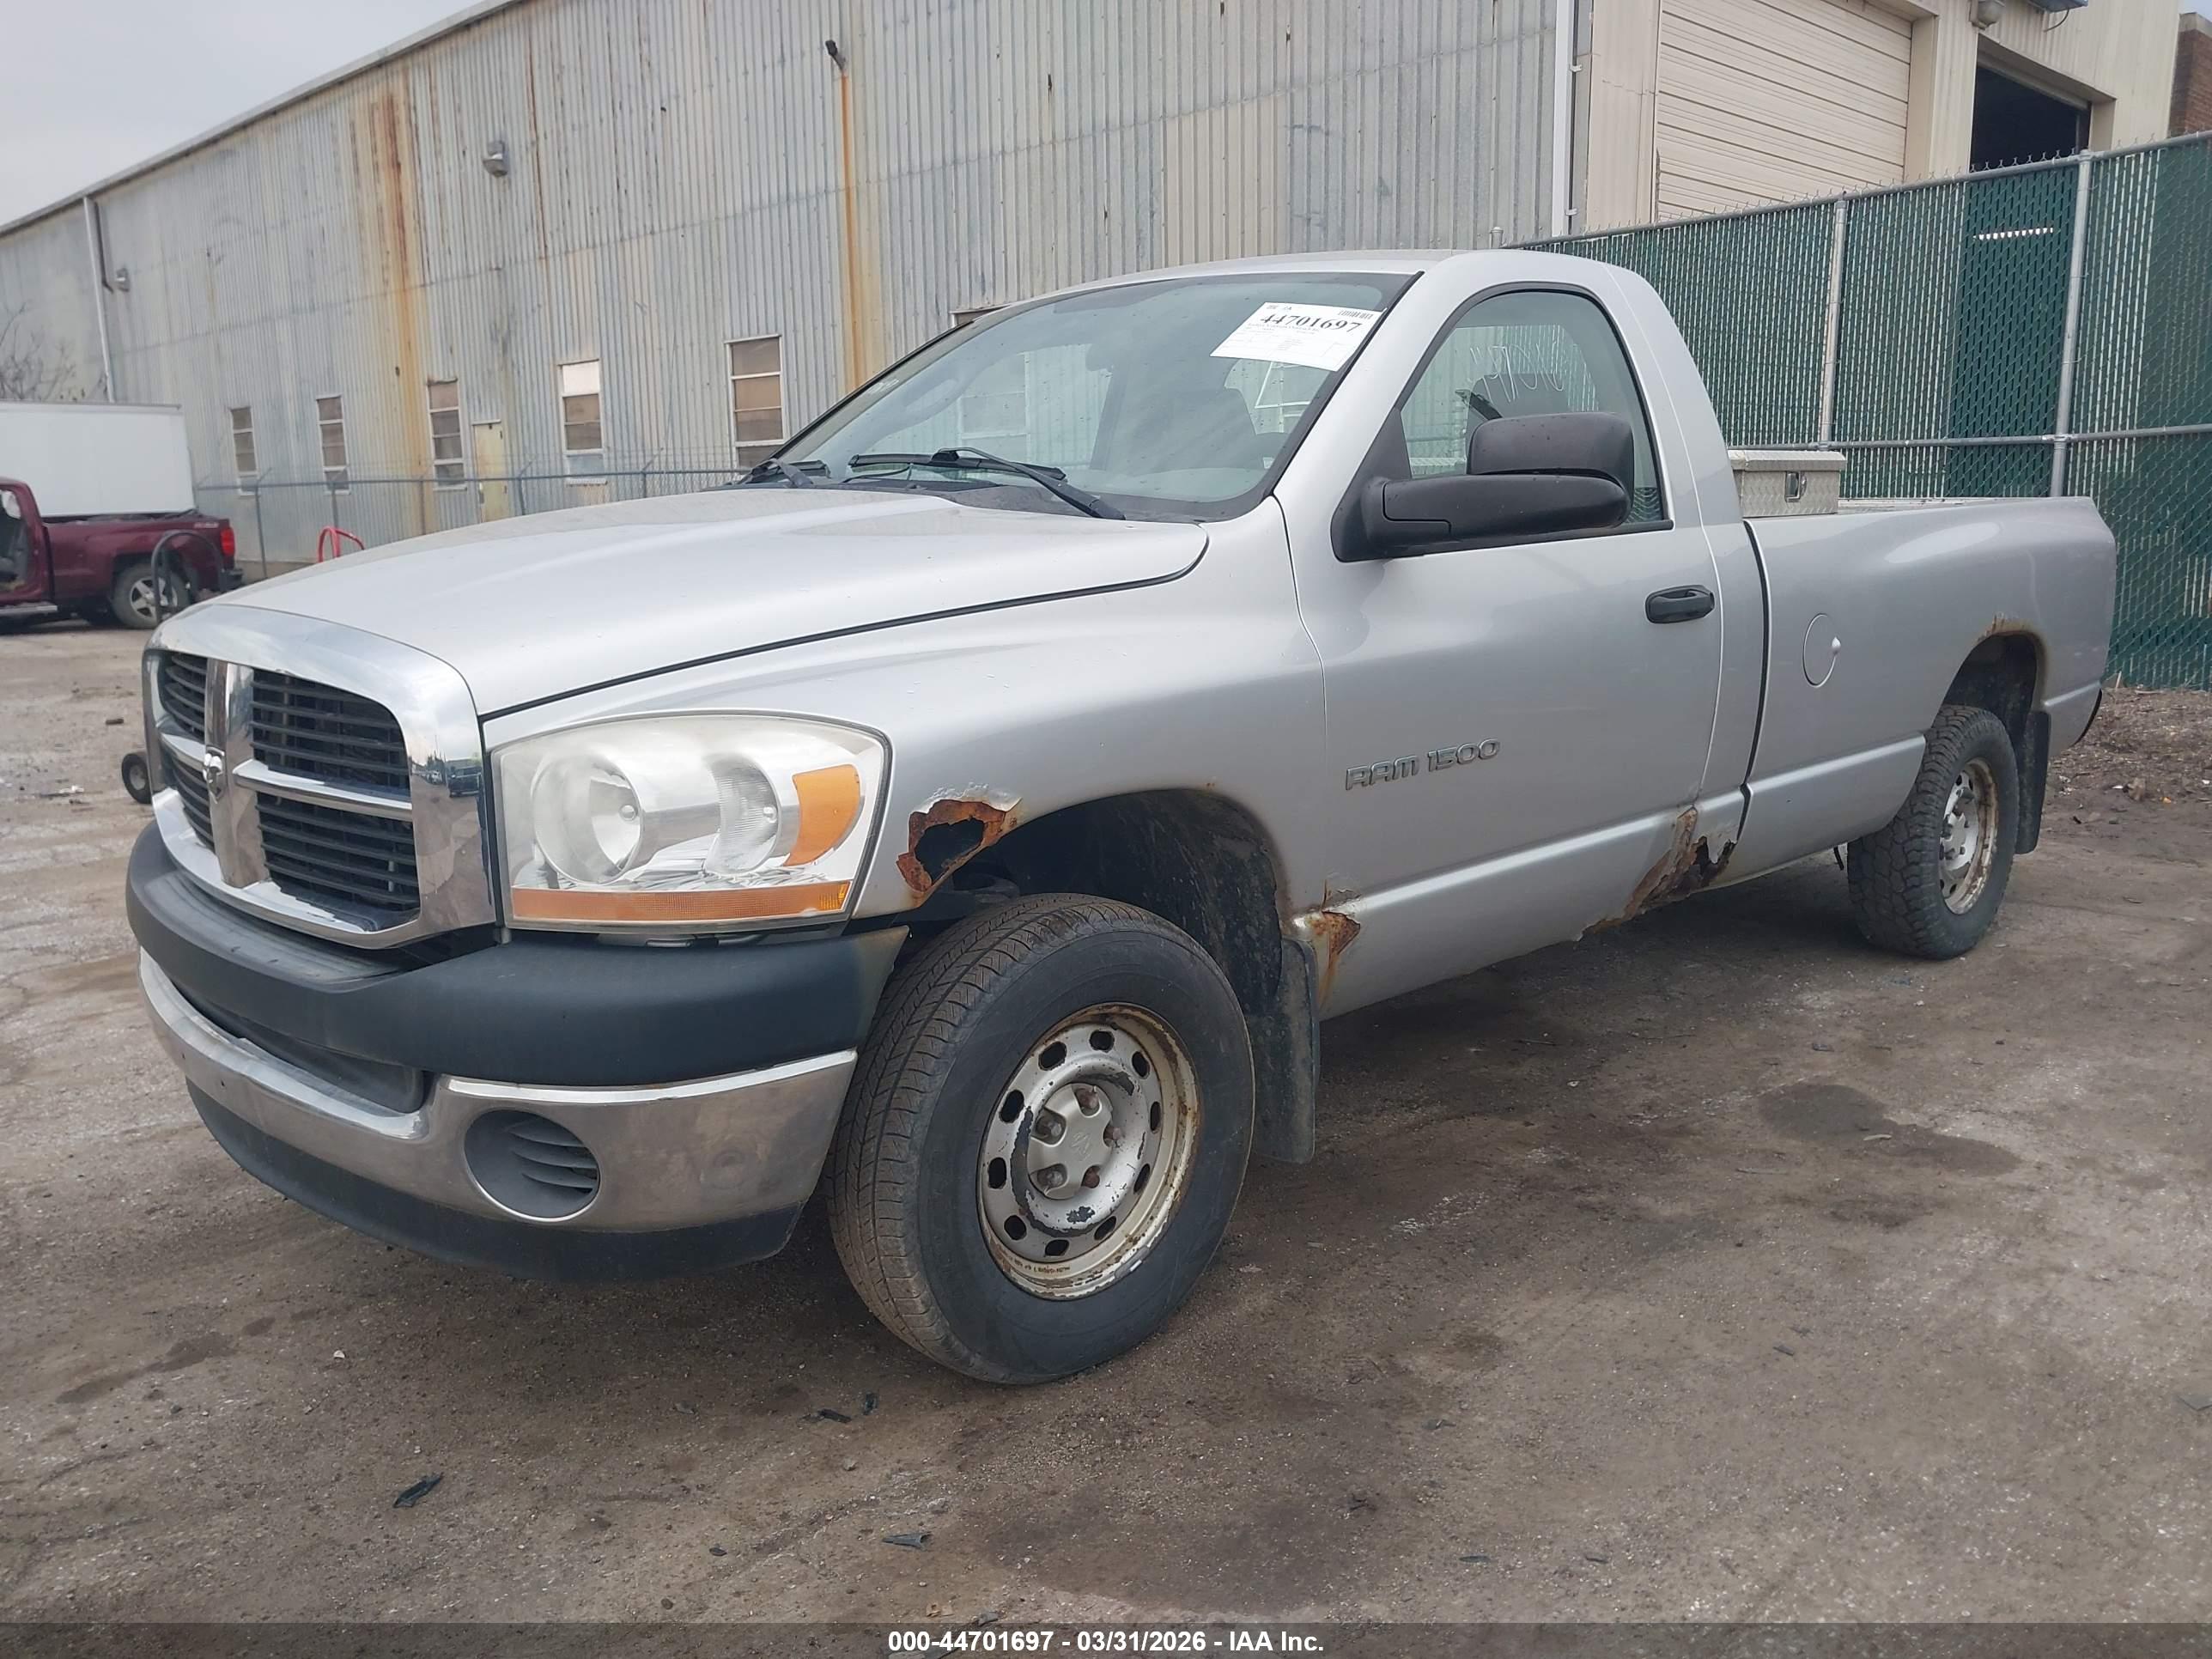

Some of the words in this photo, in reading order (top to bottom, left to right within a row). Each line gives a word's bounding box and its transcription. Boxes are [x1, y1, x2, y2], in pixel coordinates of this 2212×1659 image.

[1260, 313, 1363, 332] 44701697
[1345, 755, 1419, 791] RAM
[1427, 738, 1501, 772] 1500
